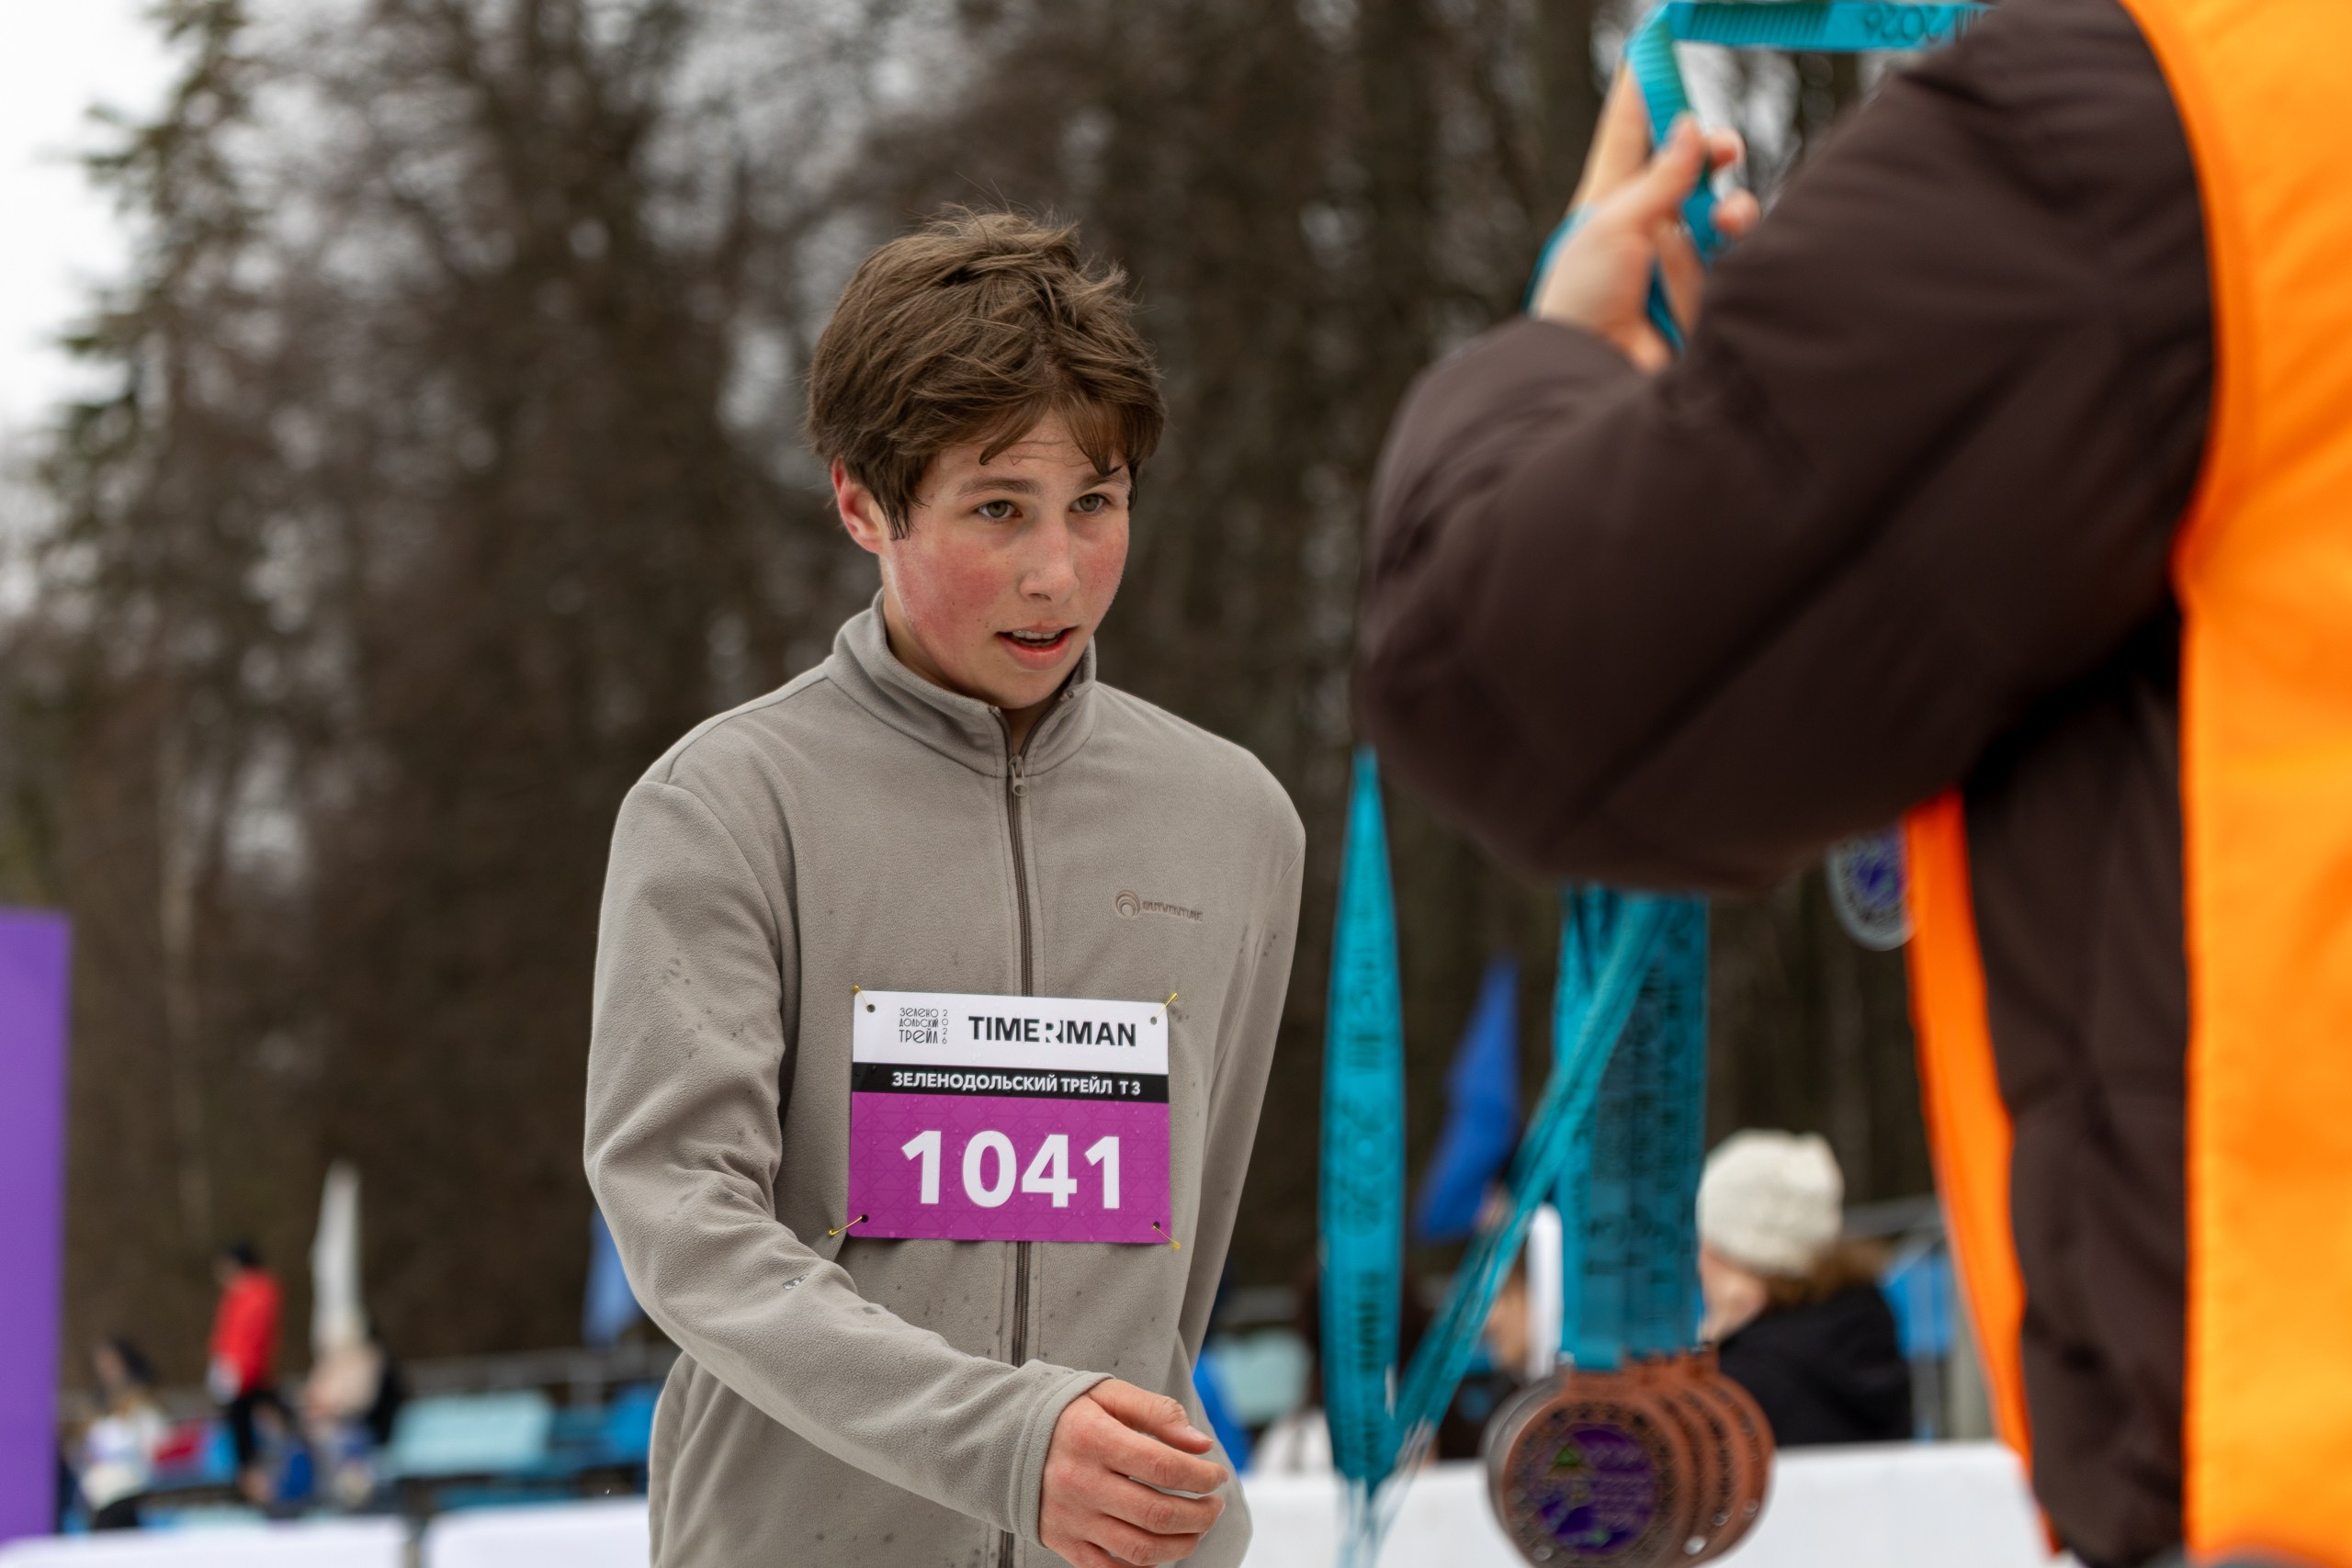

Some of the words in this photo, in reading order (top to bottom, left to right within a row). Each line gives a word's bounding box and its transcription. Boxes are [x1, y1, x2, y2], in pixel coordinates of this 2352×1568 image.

[891, 1070, 1057, 1092] ЗЕЛЕНОДОЛЬСКИЙ
[1060, 1076, 1114, 1095] ТРЕЙЛ
[901, 1130, 1120, 1209] 1041
